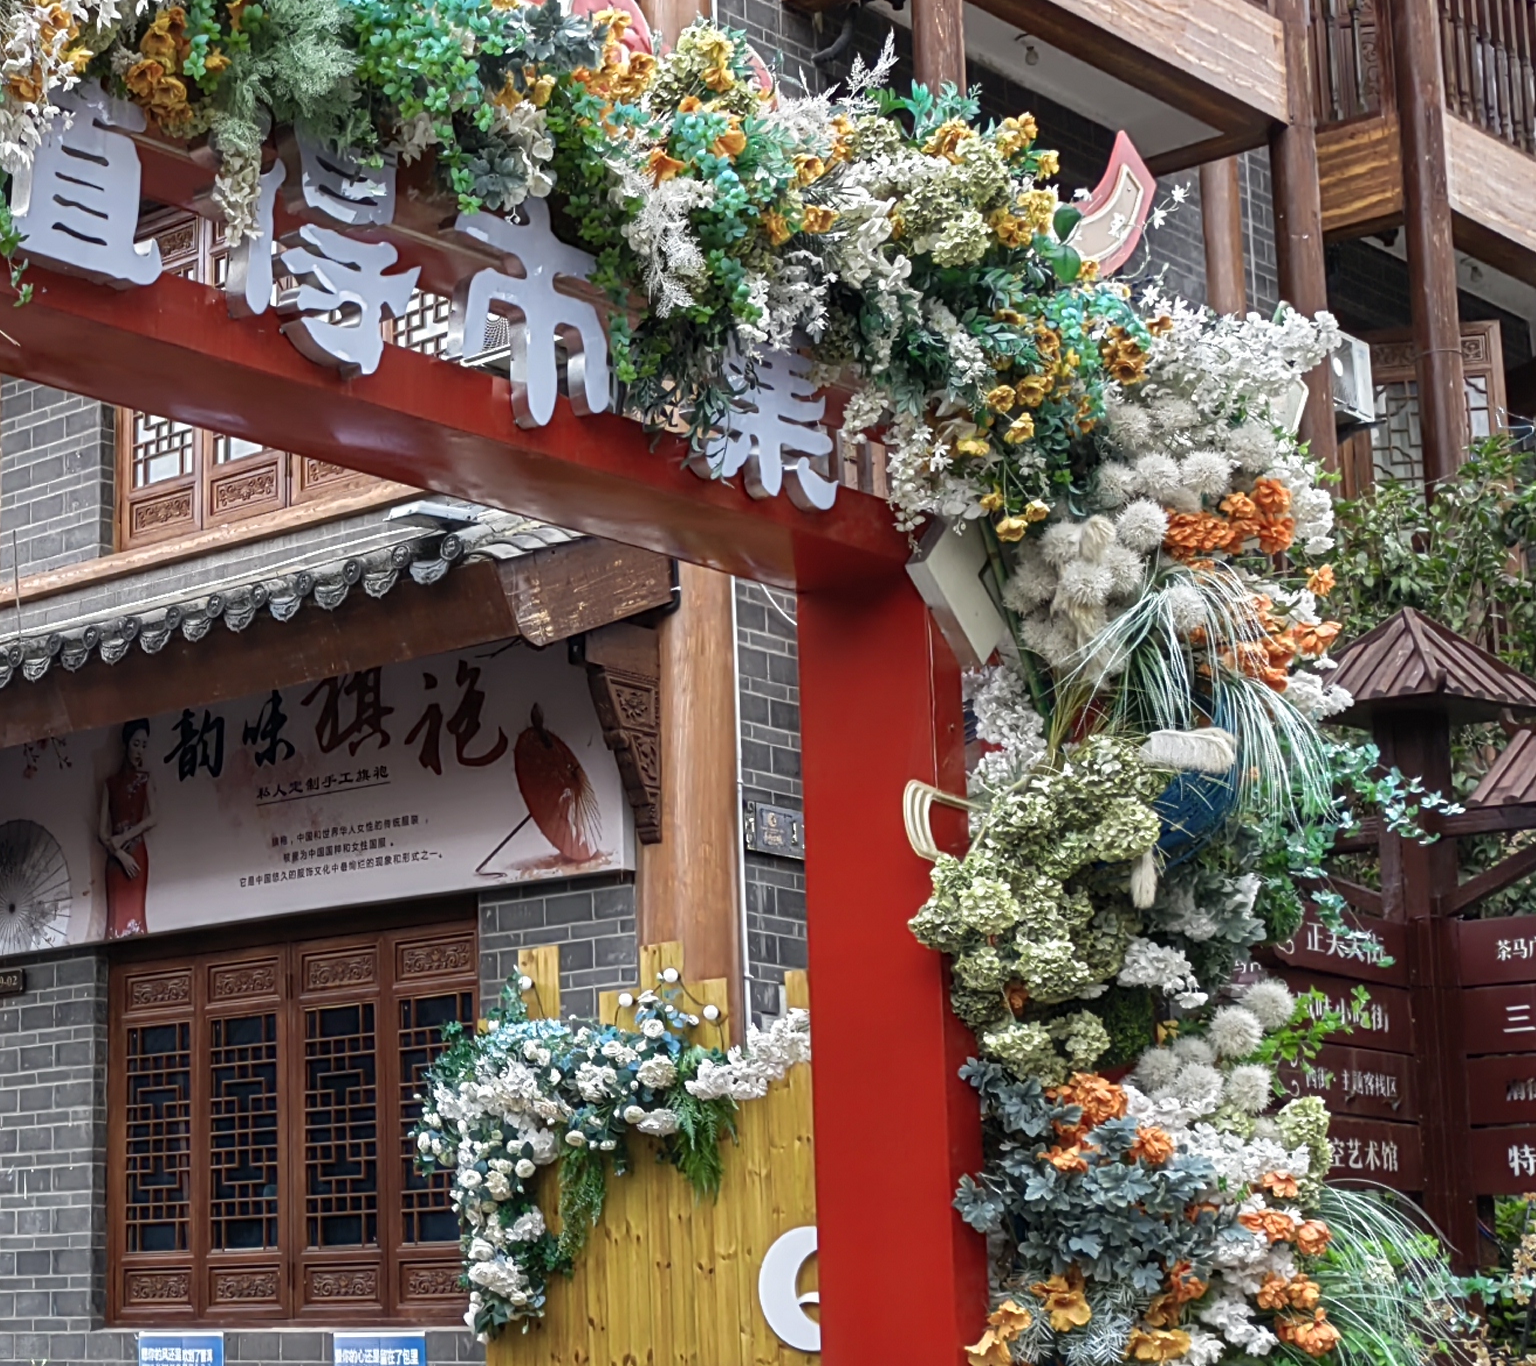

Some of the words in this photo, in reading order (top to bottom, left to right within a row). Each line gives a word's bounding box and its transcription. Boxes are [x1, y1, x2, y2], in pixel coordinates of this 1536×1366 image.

[257, 765, 390, 800] 私人定制手工旗袍
